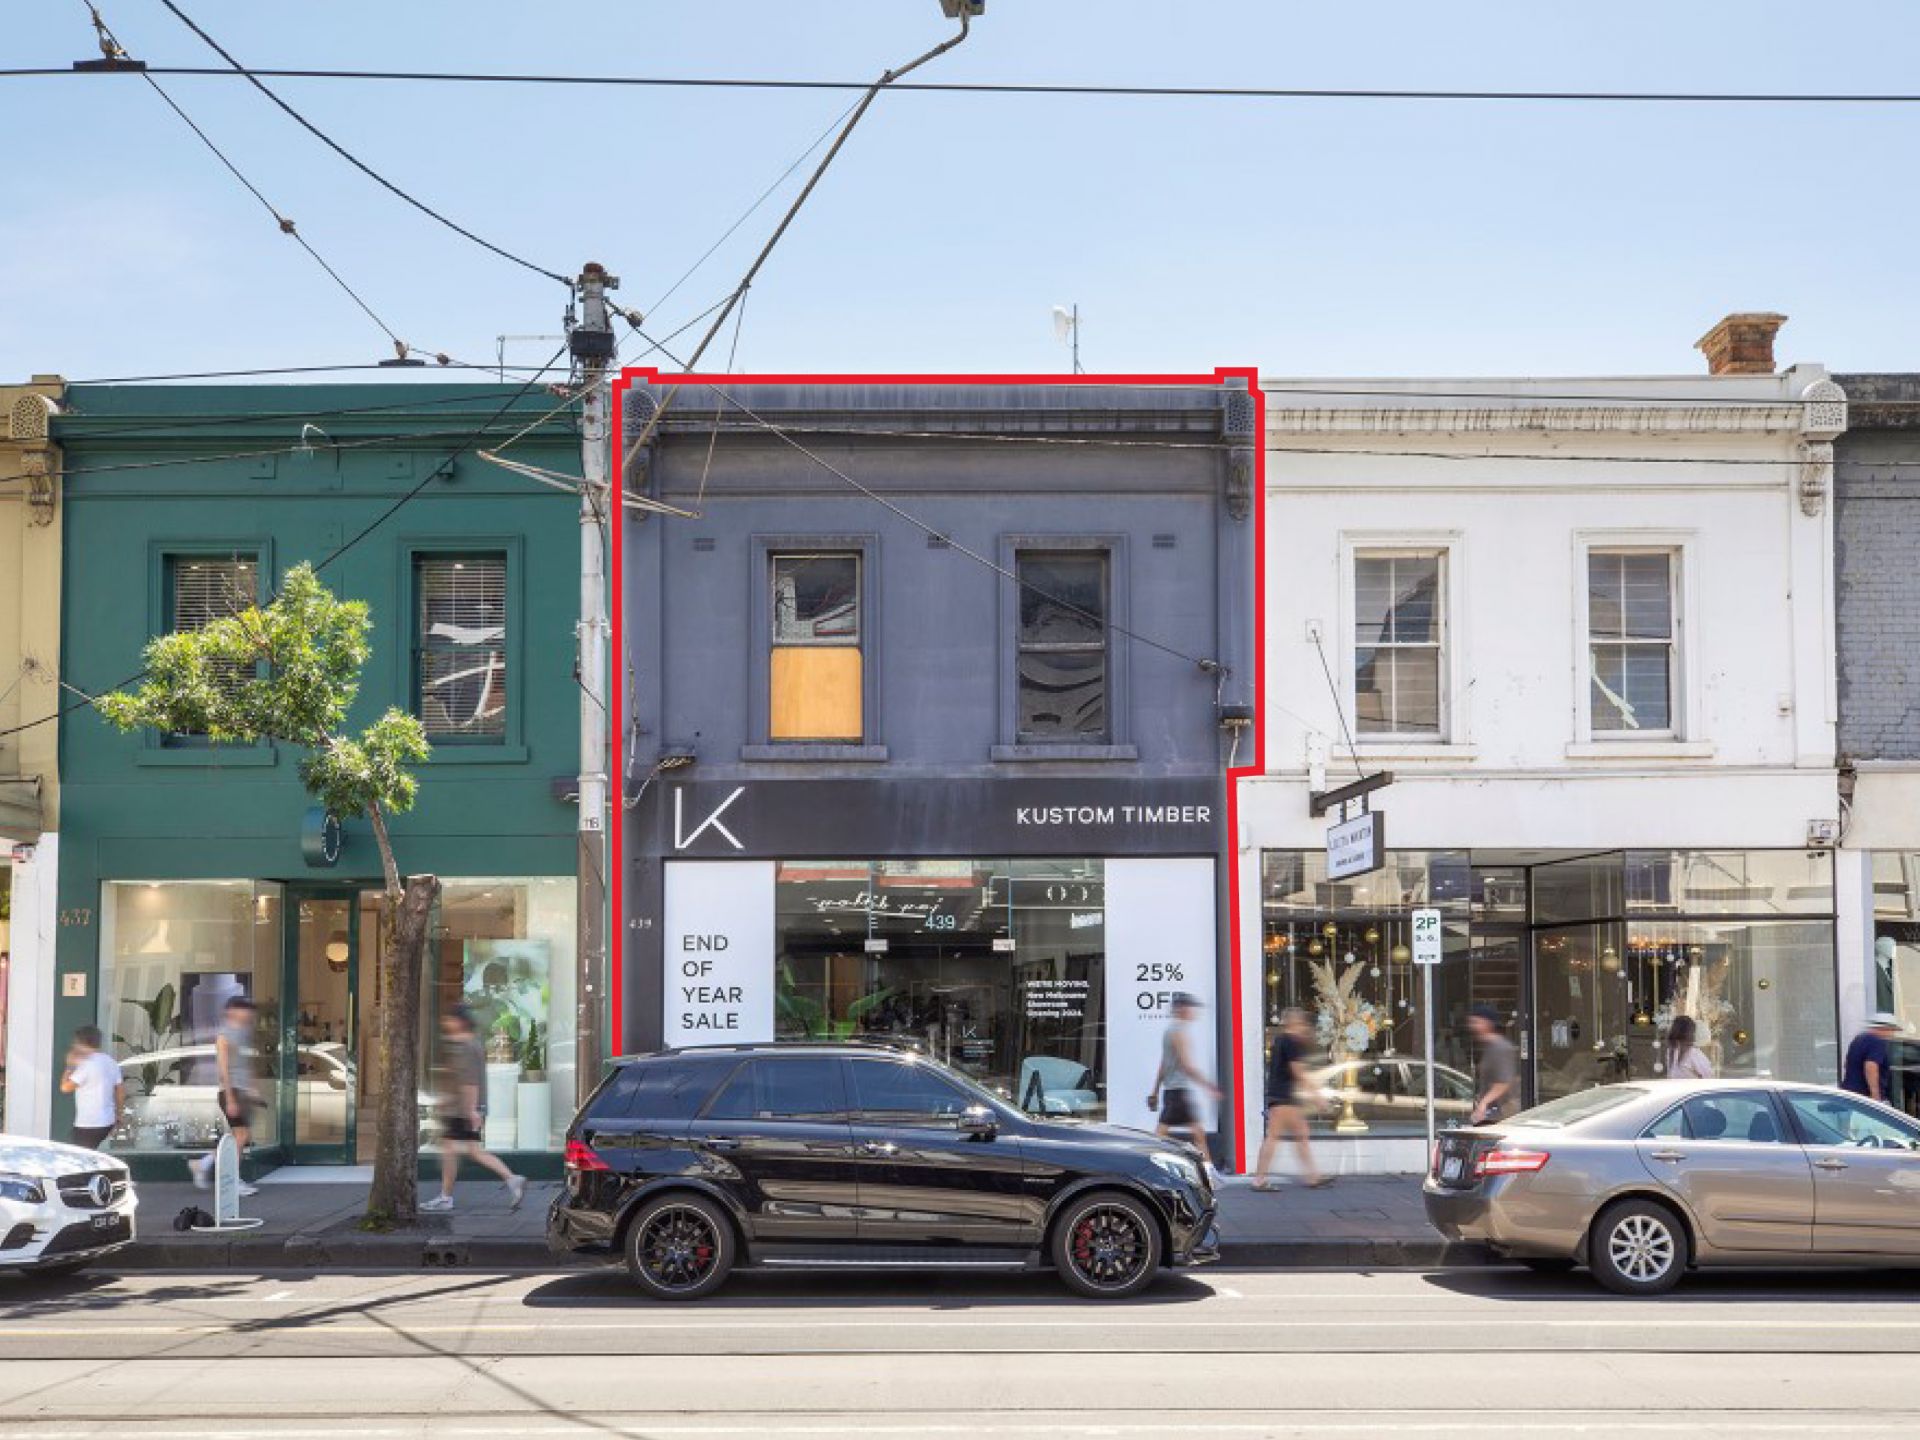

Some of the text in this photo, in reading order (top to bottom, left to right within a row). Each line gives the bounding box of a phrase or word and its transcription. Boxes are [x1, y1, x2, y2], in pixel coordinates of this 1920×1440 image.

[1016, 805, 1211, 825] KUSTOM TIMBER
[628, 918, 653, 930] 439
[925, 914, 955, 930] 439
[1415, 916, 1438, 930] 2P
[682, 934, 729, 951] END
[682, 960, 713, 977] OF
[1136, 962, 1184, 982] 25%
[681, 986, 744, 1003] YEAR
[1136, 991, 1184, 1009] OF
[681, 1012, 739, 1030] SALE
